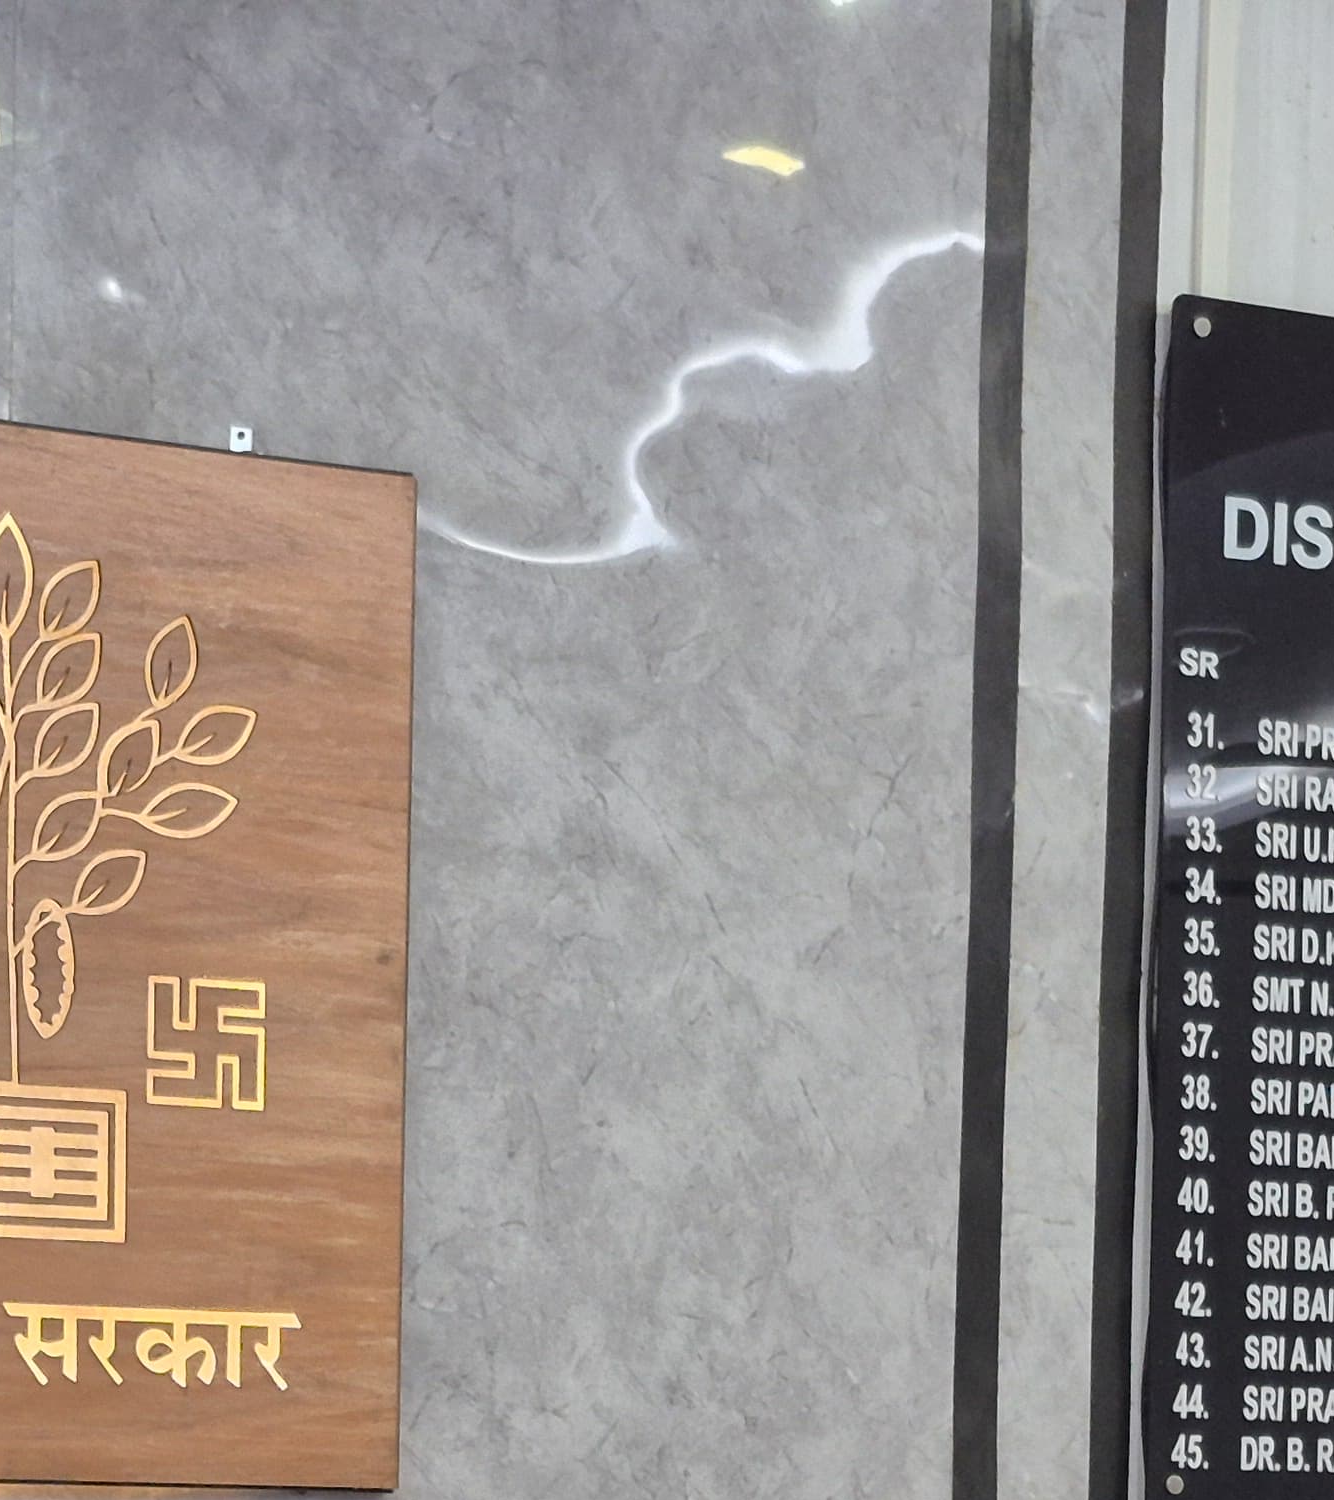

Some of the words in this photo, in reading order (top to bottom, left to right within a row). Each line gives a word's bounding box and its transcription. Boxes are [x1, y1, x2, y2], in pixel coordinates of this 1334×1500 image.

[1179, 647, 1219, 680] SR
[1187, 710, 1225, 750] 31.
[1257, 717, 1300, 758] SRI
[1186, 765, 1220, 801] 32.
[1255, 770, 1299, 809] SRI
[1185, 815, 1223, 854] 33.
[1255, 820, 1297, 860] SRI
[1185, 866, 1222, 906] 34.
[1254, 872, 1296, 912] SRI
[1183, 917, 1221, 957] 35.
[1253, 923, 1296, 963] SRI
[1182, 970, 1220, 1009] 36.
[1252, 975, 1305, 1014] SMT
[1310, 980, 1334, 1017] N.
[1180, 1021, 1219, 1060] 37.
[1250, 1026, 1293, 1065] SRI
[1180, 1074, 1217, 1111] 38.
[1250, 1077, 1292, 1116] SRI
[1178, 1124, 1216, 1163] 39.
[1249, 1128, 1291, 1166] SRI
[1177, 1176, 1215, 1214] 40.
[1247, 1180, 1290, 1218] SRI
[1295, 1182, 1319, 1220] B.
[1175, 1229, 1214, 1267] 41.
[1246, 1232, 1289, 1270] SRI
[1174, 1280, 1212, 1318] 42.
[1245, 1283, 1287, 1321] SRI
[2, 1300, 302, 1392] सरकार
[1175, 1331, 1211, 1369] 43.
[1243, 1334, 1286, 1371] SRI
[1172, 1383, 1209, 1420] 44.
[1242, 1384, 1285, 1422] SRI
[1170, 1433, 1209, 1470] 45.
[1240, 1435, 1281, 1472] DR.
[1286, 1436, 1311, 1472] B.
